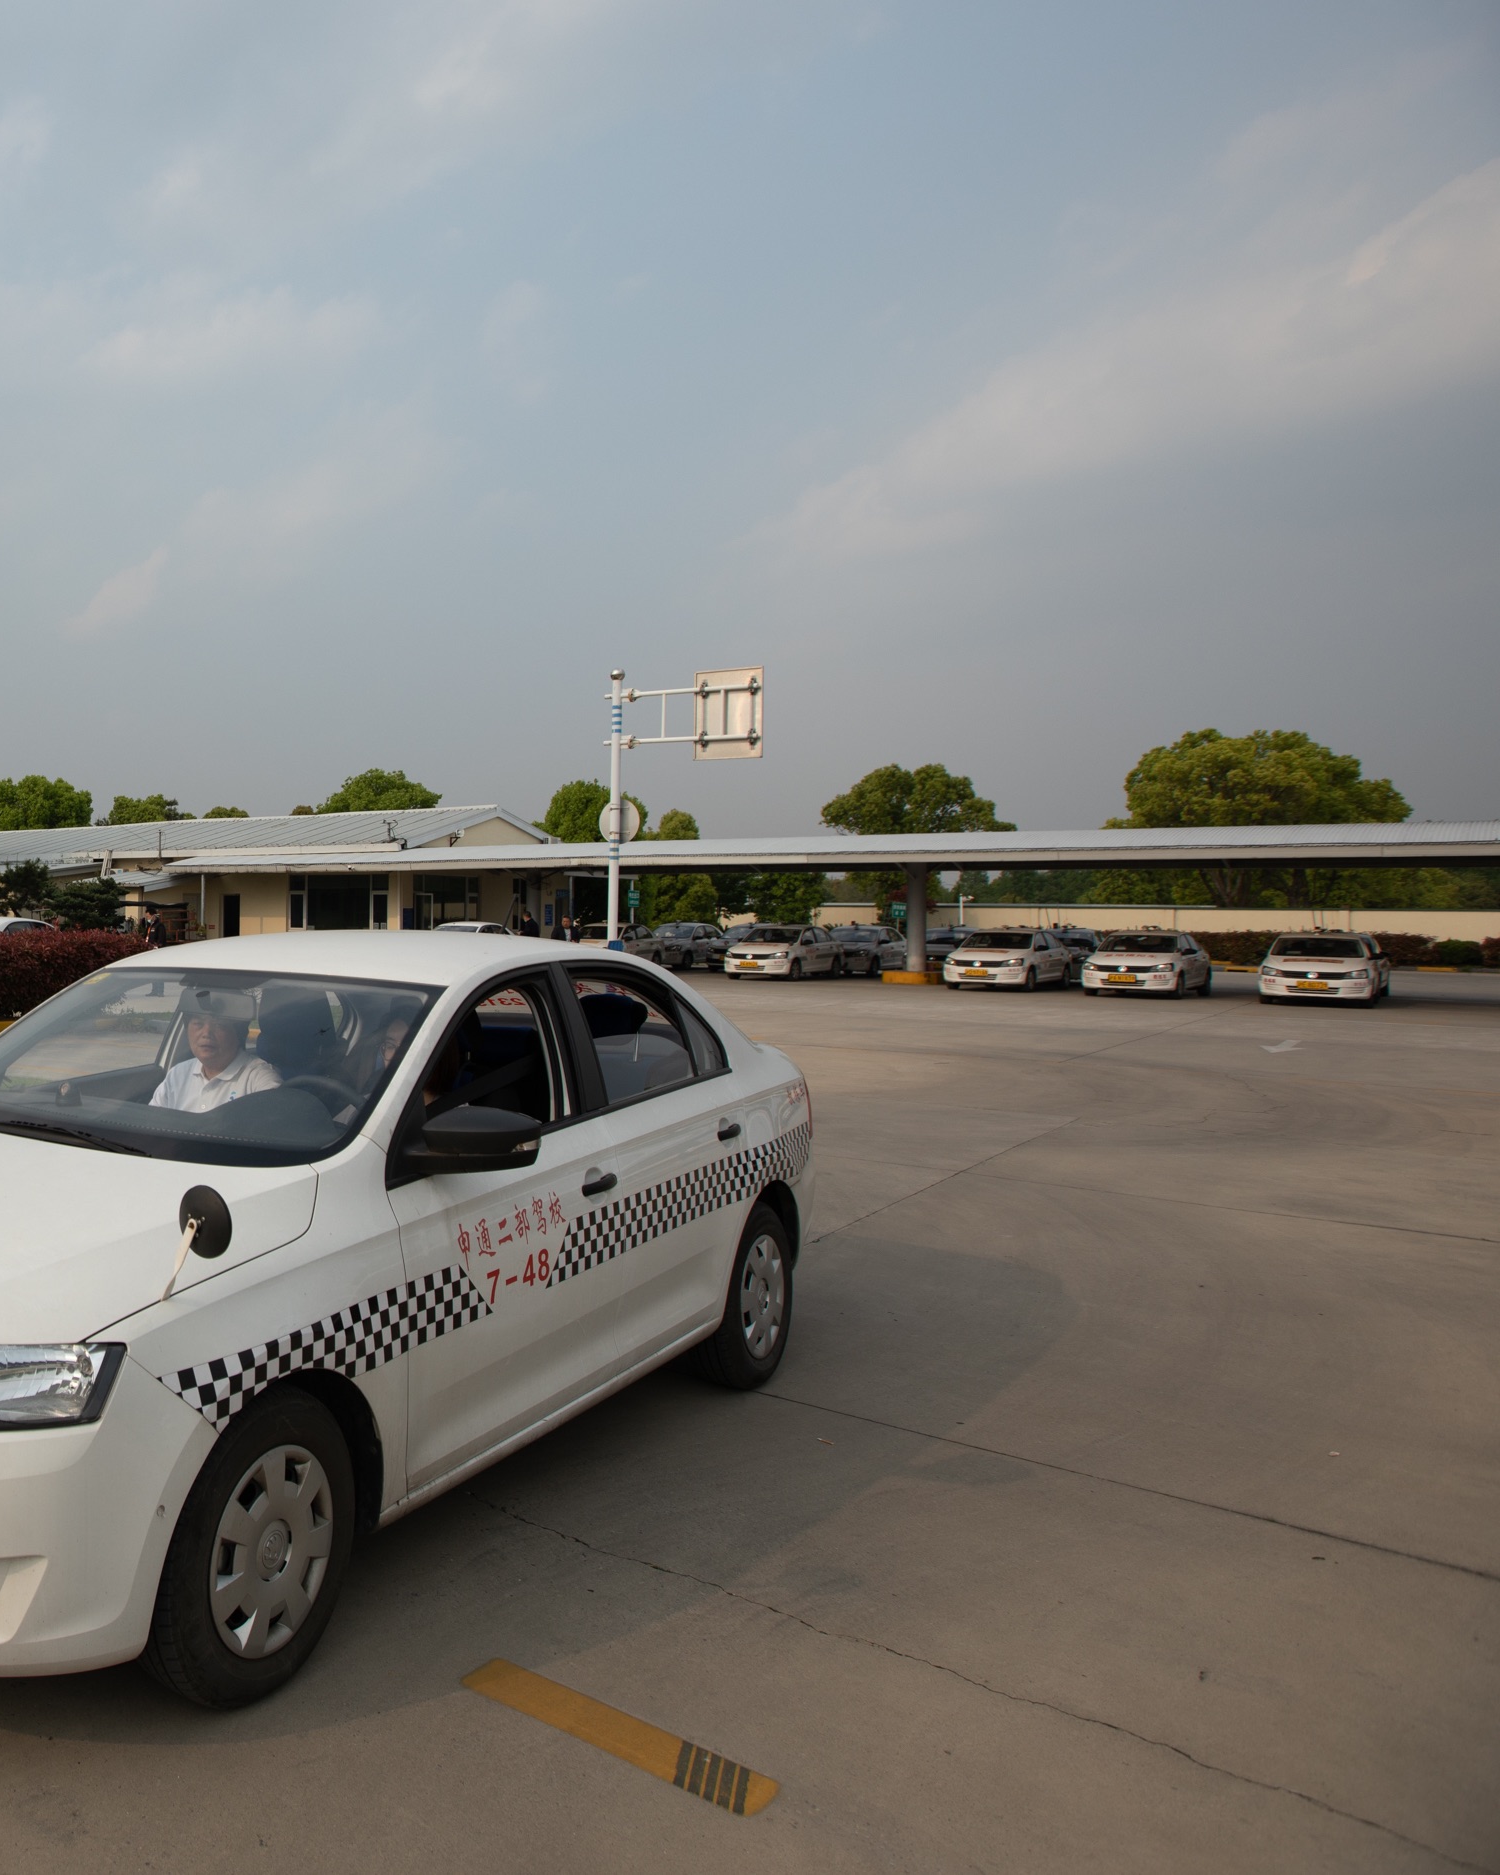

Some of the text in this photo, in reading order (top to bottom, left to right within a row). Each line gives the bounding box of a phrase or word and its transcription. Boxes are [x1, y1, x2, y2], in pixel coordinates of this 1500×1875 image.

[457, 1191, 567, 1271] 申通二部驾校
[486, 1248, 550, 1305] 7-48
